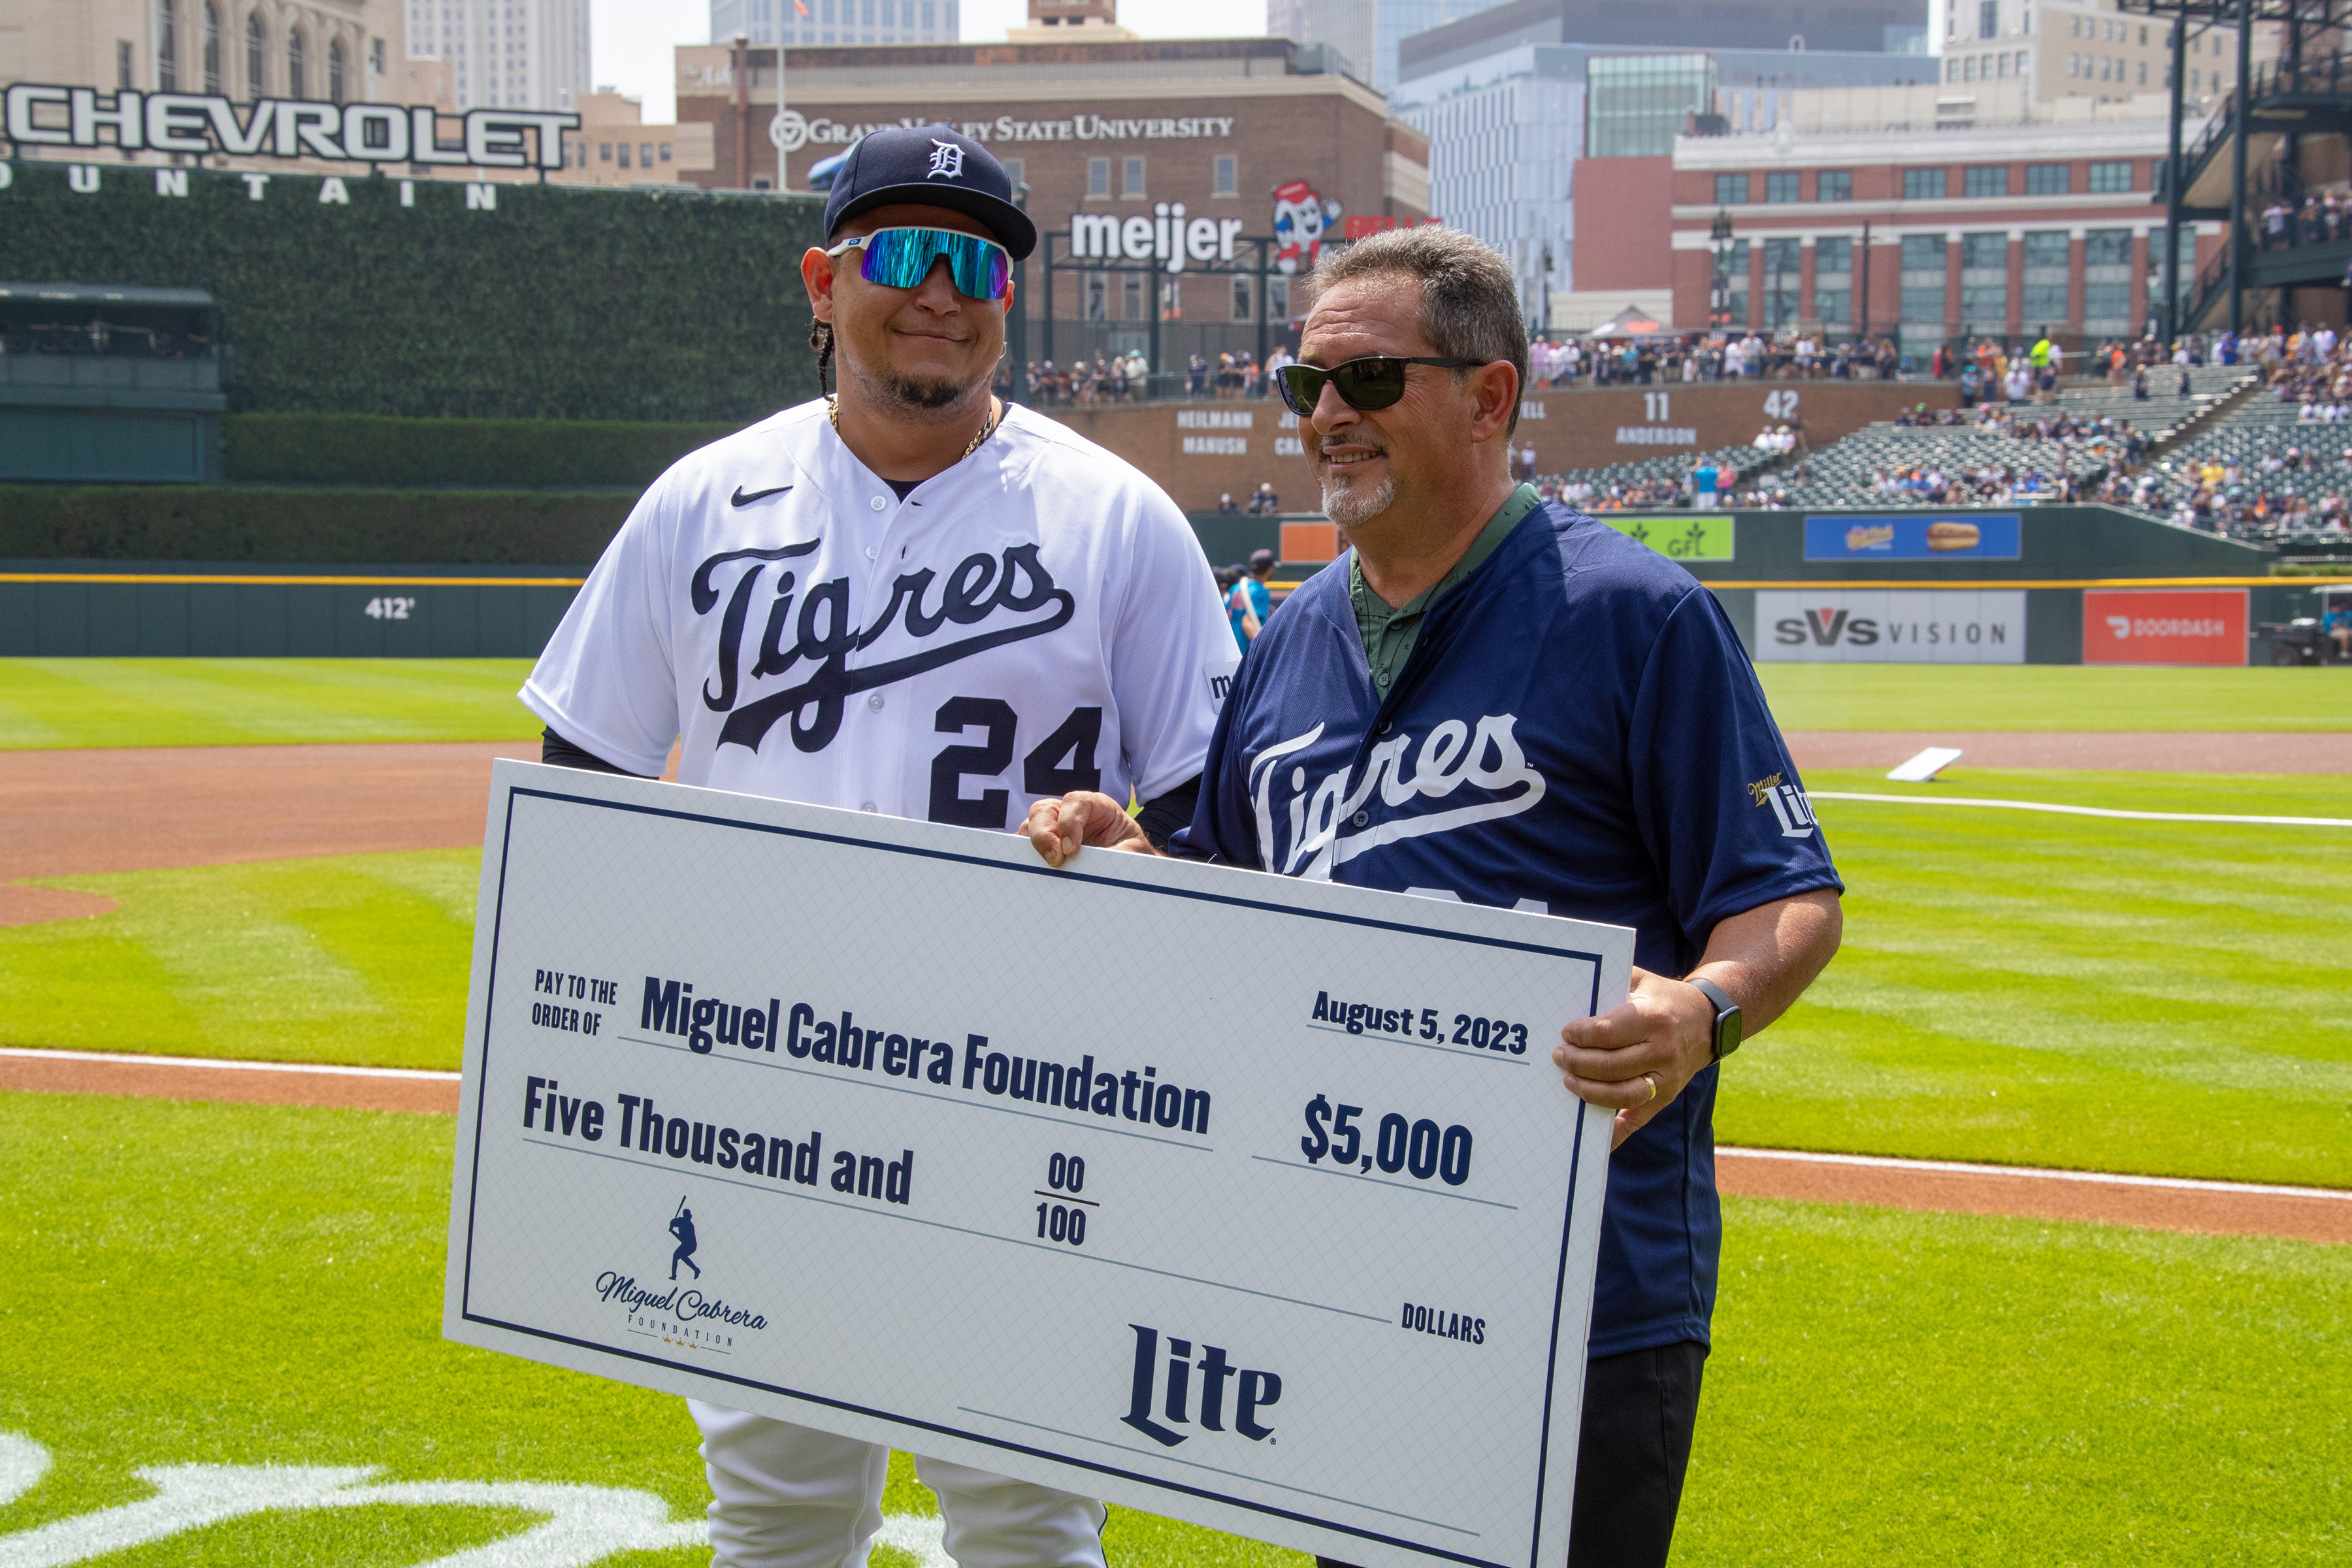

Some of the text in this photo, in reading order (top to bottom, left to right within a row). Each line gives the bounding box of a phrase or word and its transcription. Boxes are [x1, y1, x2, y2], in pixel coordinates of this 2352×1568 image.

[7, 85, 580, 168] CHEVROLET
[994, 116, 1073, 141] STATE
[1073, 115, 1234, 140] UNIVERSITY
[1071, 202, 1243, 273] meijer
[1644, 390, 1799, 421] 11 42
[1616, 427, 1697, 445] ANDERSON
[1667, 532, 1705, 557] GFL
[691, 537, 1075, 754] Tigres
[1888, 623, 2006, 644] VISION
[2134, 618, 2225, 637] DOORDASH
[928, 696, 1102, 828] 24
[1249, 713, 1546, 882] Tigres
[1747, 772, 1782, 807] Miller
[535, 970, 618, 1005] PAY TO THE
[532, 1002, 601, 1036] ORDER OF
[1312, 990, 1528, 1055] August 5, 2023
[641, 976, 1211, 1135] Miguel Cabrera Foundation
[523, 1075, 914, 1205] Five Thousand and
[1301, 1093, 1473, 1186] $5,000
[1048, 1152, 1085, 1194] 00
[1036, 1201, 1086, 1246] 100
[595, 1271, 768, 1330] Miguel Cabrera
[627, 1315, 733, 1347] FOUNDATION
[1401, 1302, 1486, 1345] DOLLARS
[1119, 1323, 1282, 1447] Lite
